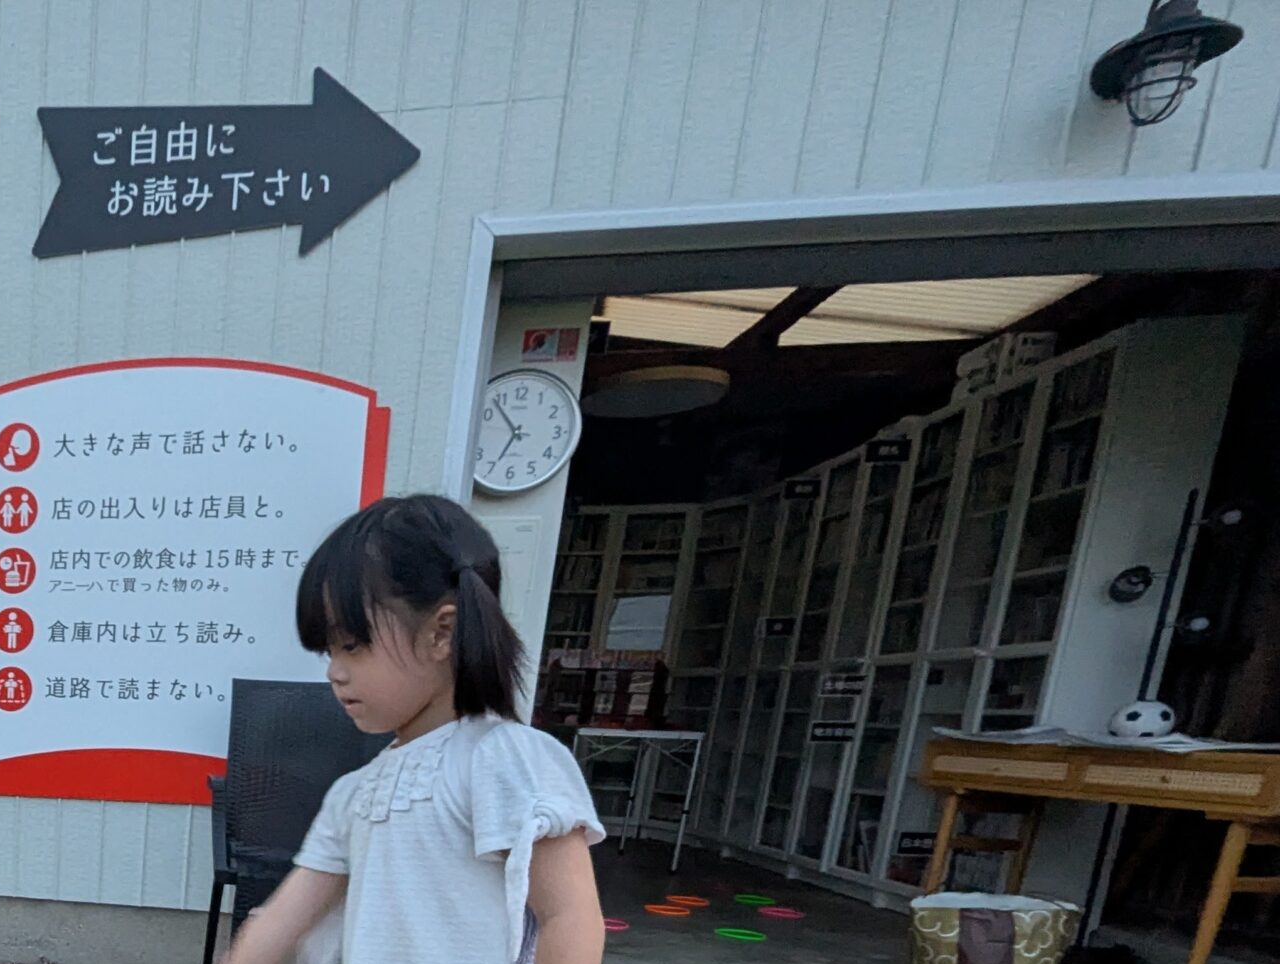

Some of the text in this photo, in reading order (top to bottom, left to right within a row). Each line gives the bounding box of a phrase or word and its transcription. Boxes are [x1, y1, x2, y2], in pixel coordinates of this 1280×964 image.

[93, 121, 235, 165] ご自由に
[107, 168, 330, 216] お読み下さい
[515, 387, 528, 400] 12
[537, 392, 543, 405] 1
[548, 405, 559, 419] 2
[552, 427, 562, 439] 3
[53, 429, 297, 458] 大きな声で話さない。
[542, 446, 552, 459] 4
[488, 461, 497, 474] 7
[505, 466, 515, 479] 6
[527, 461, 537, 474] 5
[51, 495, 284, 520] 店の出入りは店員と。
[48, 577, 229, 593] アニーハで買った物のみ。
[47, 620, 257, 644] 倉庫内は立ち読み。
[44, 676, 226, 702] 道路で読まない。
